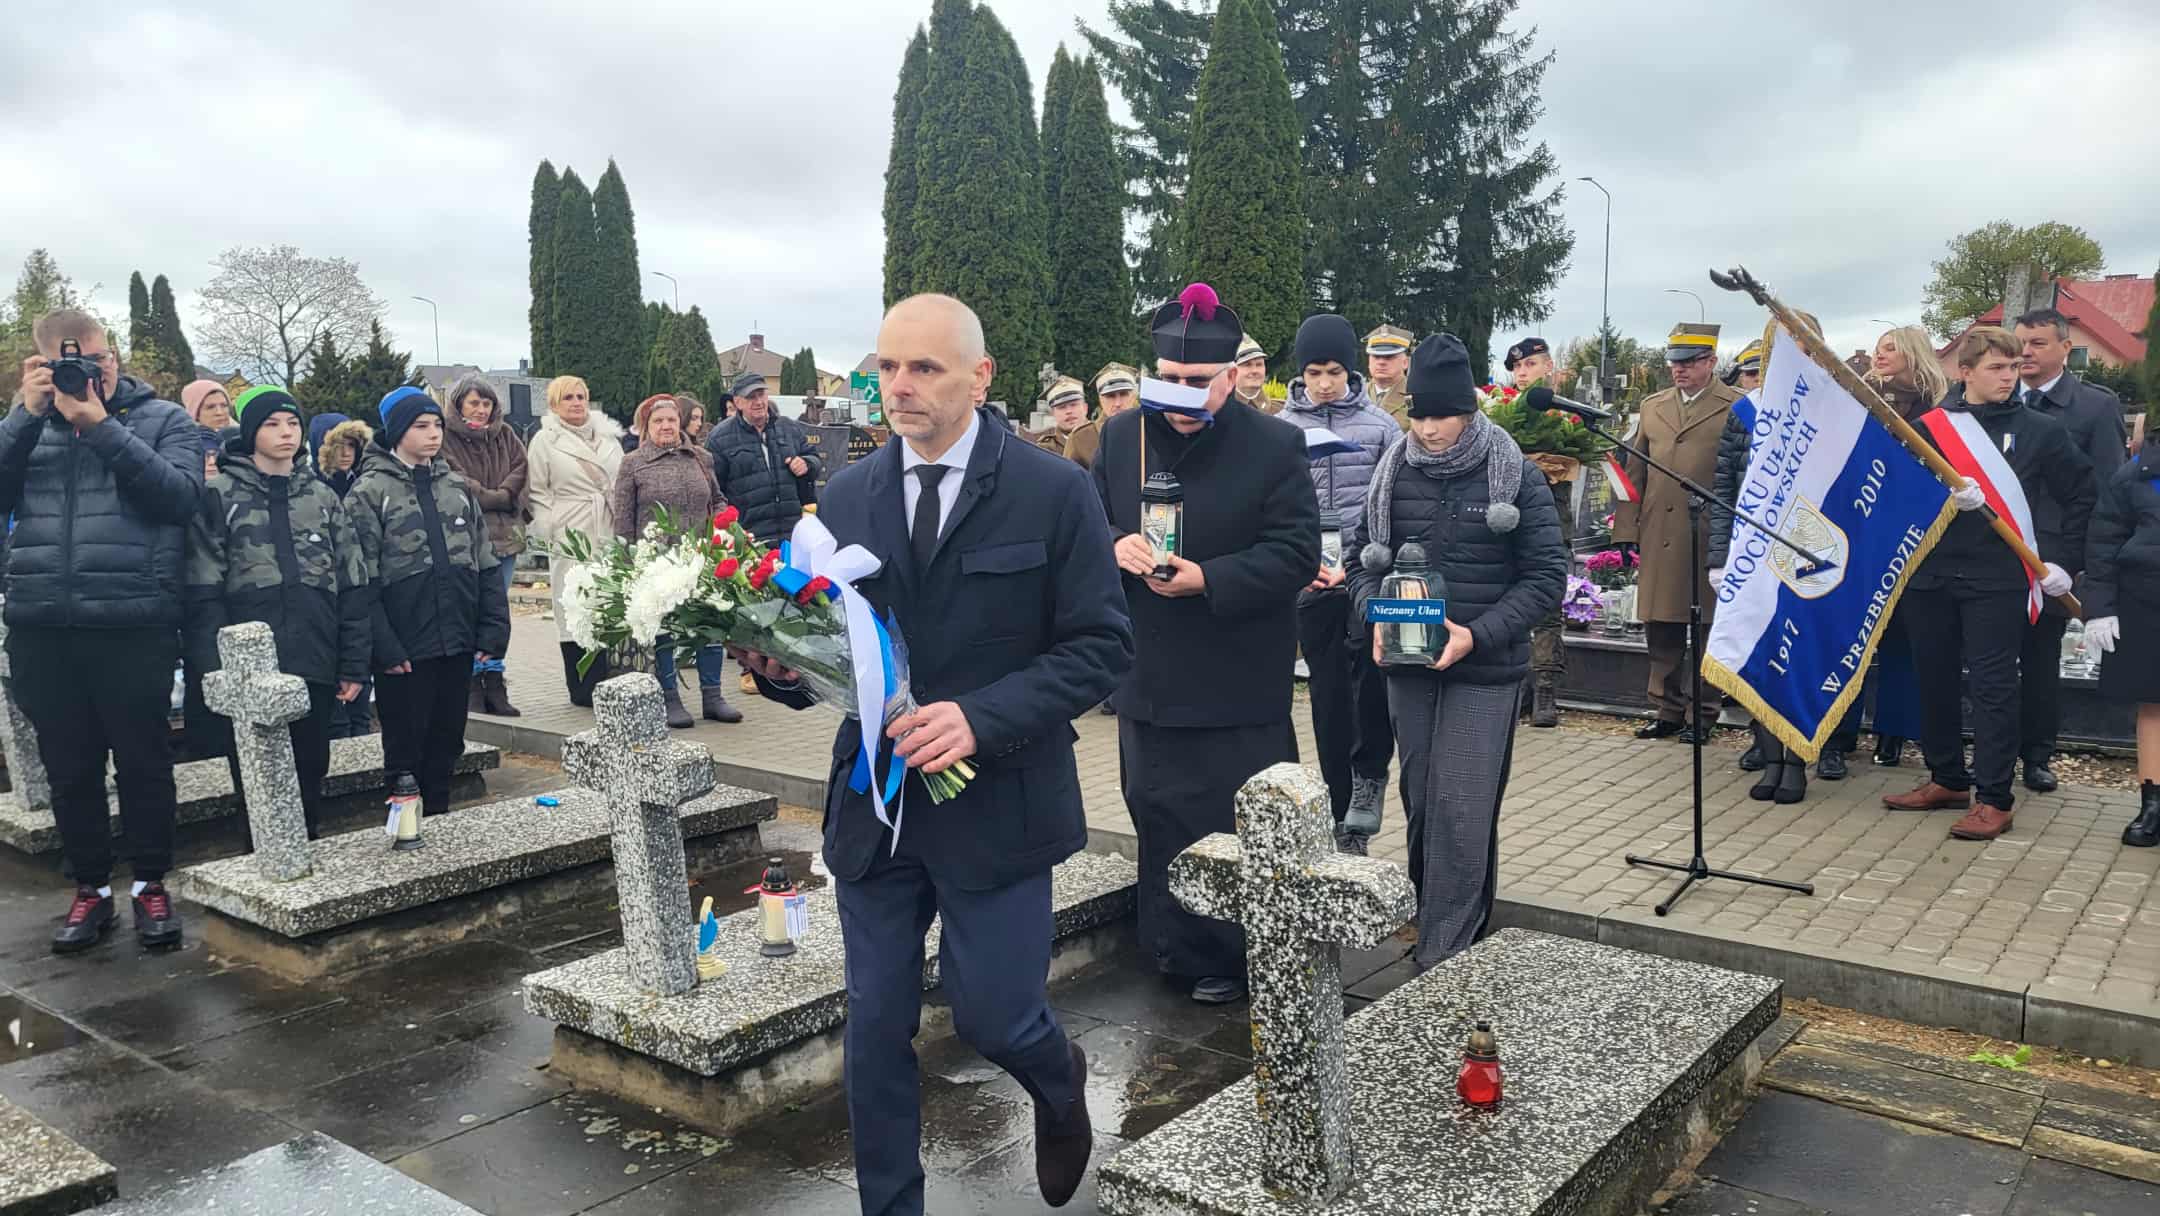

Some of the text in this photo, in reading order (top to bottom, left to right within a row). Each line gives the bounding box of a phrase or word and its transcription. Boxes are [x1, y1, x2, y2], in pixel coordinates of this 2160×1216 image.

[1854, 459, 1886, 518] 2010
[1373, 605, 1415, 617] Nieznany
[1820, 524, 1925, 693] W PRZEBRODZIE
[1768, 618, 1800, 676] 1917
